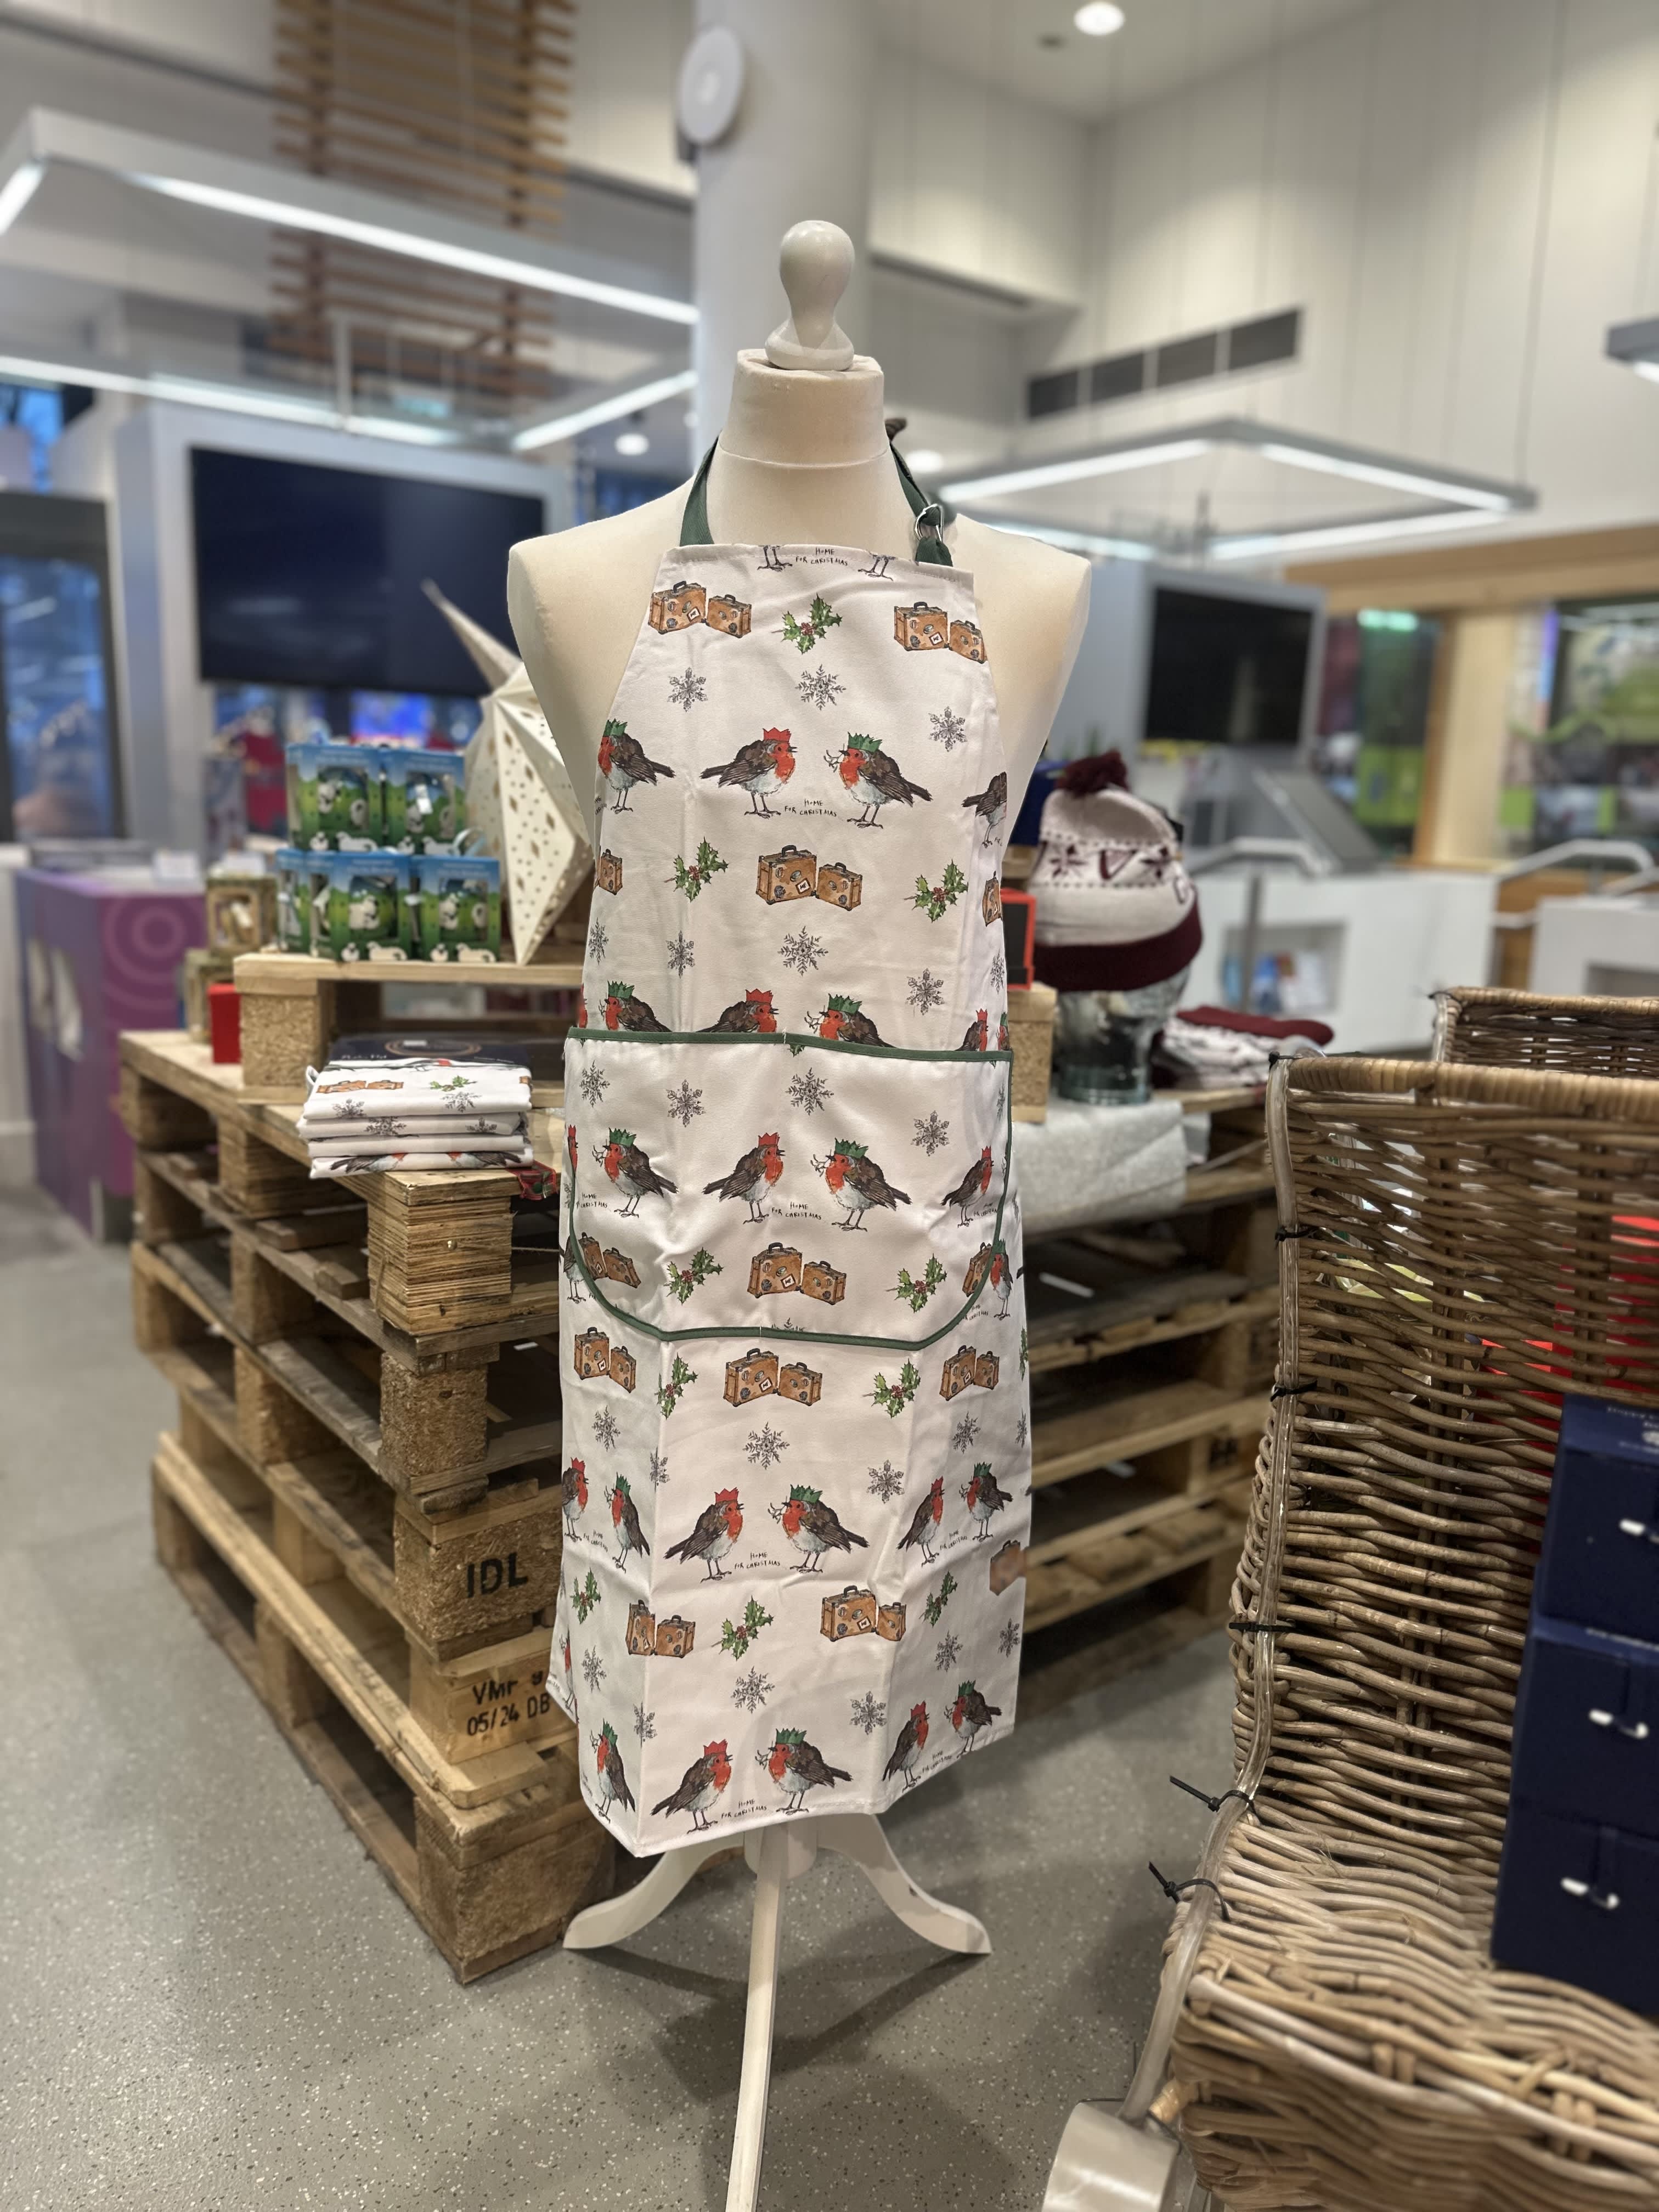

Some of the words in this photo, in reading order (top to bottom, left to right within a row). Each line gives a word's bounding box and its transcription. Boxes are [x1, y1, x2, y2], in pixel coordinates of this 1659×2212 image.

[815, 547, 836, 555] HOME
[804, 798, 823, 807] HOME
[785, 805, 797, 814] FOR
[799, 809, 837, 817] CHRISTMAS
[790, 1201, 808, 1210] HOME
[772, 1207, 783, 1216] FOR
[785, 1212, 822, 1220] CHRISTMAS
[750, 1551, 768, 1560] HOME
[746, 1560, 780, 1569] CHRISTMAS
[467, 1552, 528, 1598] IDL
[467, 1703, 520, 1736] 05/24
[527, 1692, 551, 1719] DB
